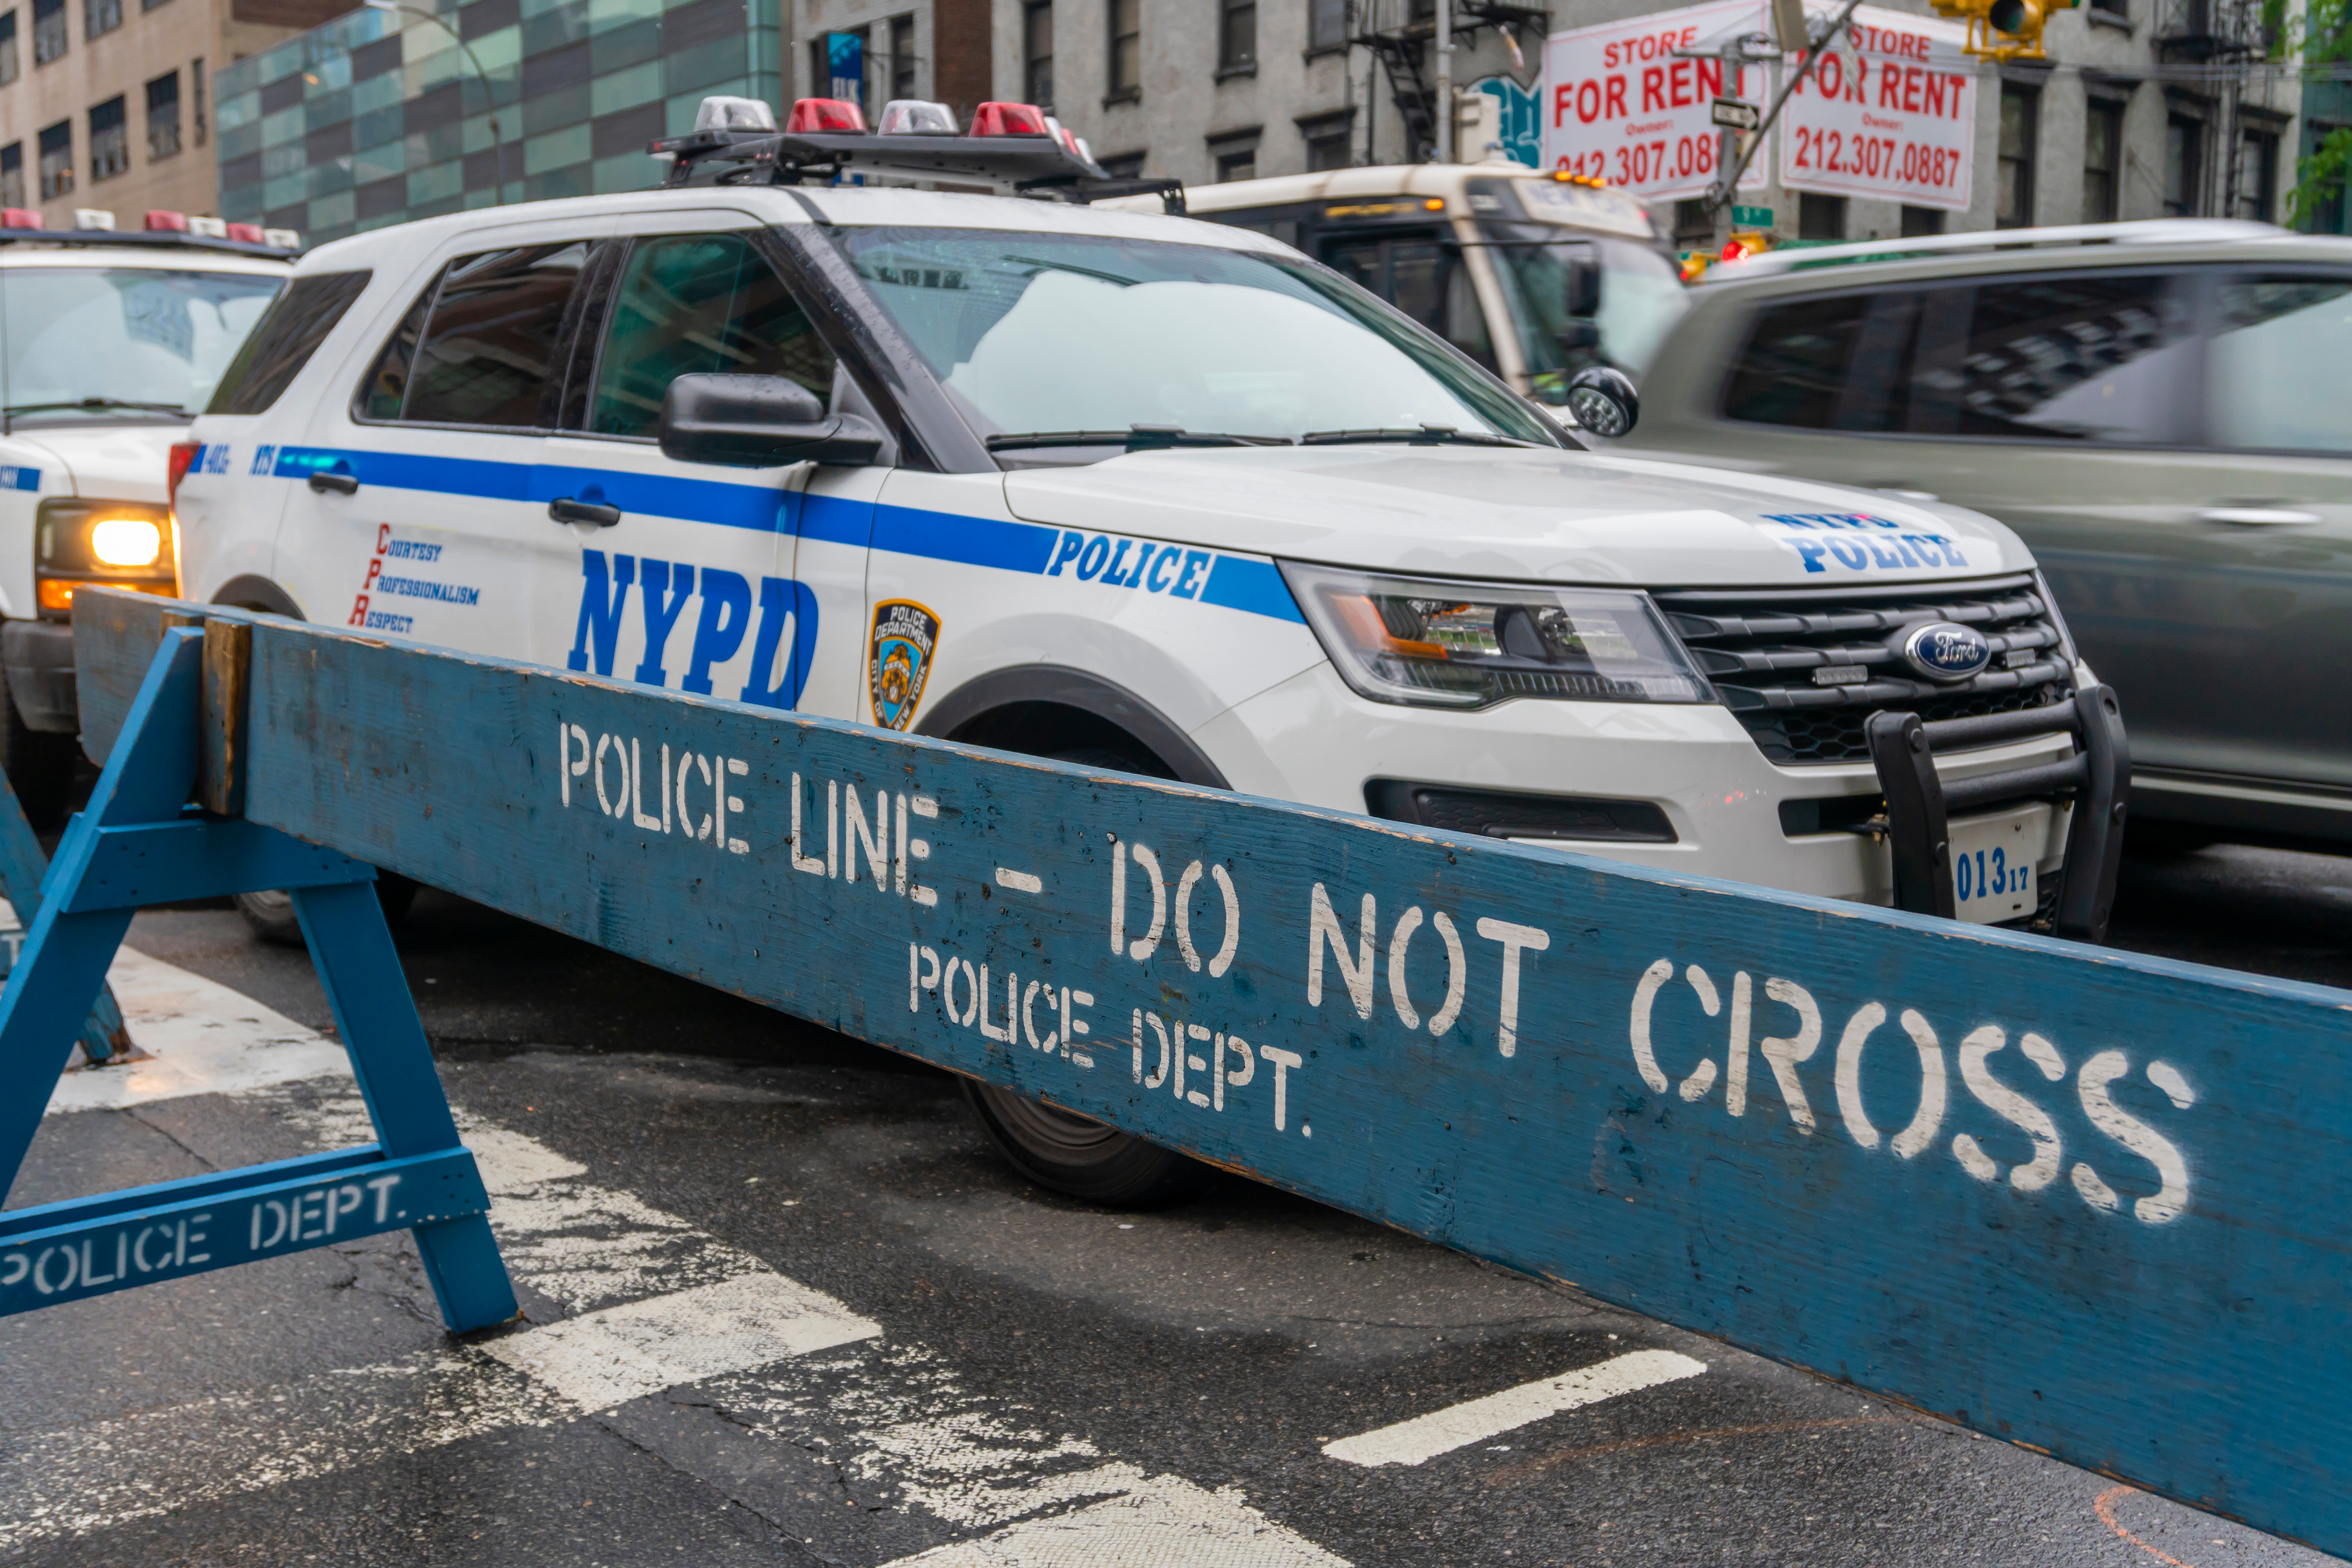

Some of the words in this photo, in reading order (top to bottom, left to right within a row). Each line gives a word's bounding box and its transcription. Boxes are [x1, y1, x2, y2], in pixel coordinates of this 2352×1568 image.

[1603, 26, 1698, 68] STORE
[1851, 25, 1931, 63] STORE
[1555, 73, 1627, 128] FOR
[1642, 56, 1745, 114] REN
[1879, 62, 1966, 120] RENT
[1557, 132, 1746, 186] 12.307.08
[1795, 124, 1961, 189] 212.307.0887
[376, 522, 442, 562] COURTESY
[1047, 530, 1211, 600] POLICE
[1780, 534, 1969, 573] POLICE
[363, 558, 480, 605] PROFESSIONALISM
[347, 594, 413, 633] RESPECT
[567, 548, 819, 711] NYPD
[874, 621, 932, 656] DEPARTMENT
[890, 606, 927, 631] POLICE
[1935, 631, 1978, 664] Ford
[875, 701, 883, 718] OF
[894, 704, 910, 731] NEW
[909, 665, 927, 701] YORK
[561, 723, 749, 855] POLICE
[791, 772, 938, 906] LINE
[1111, 841, 1240, 978] DO
[1308, 882, 1550, 1058] NOT
[1630, 958, 2195, 1225] CROSS
[909, 942, 1095, 1068] POLICE
[1132, 1009, 1313, 1138] DEPT.
[250, 1175, 407, 1250] DEPT.
